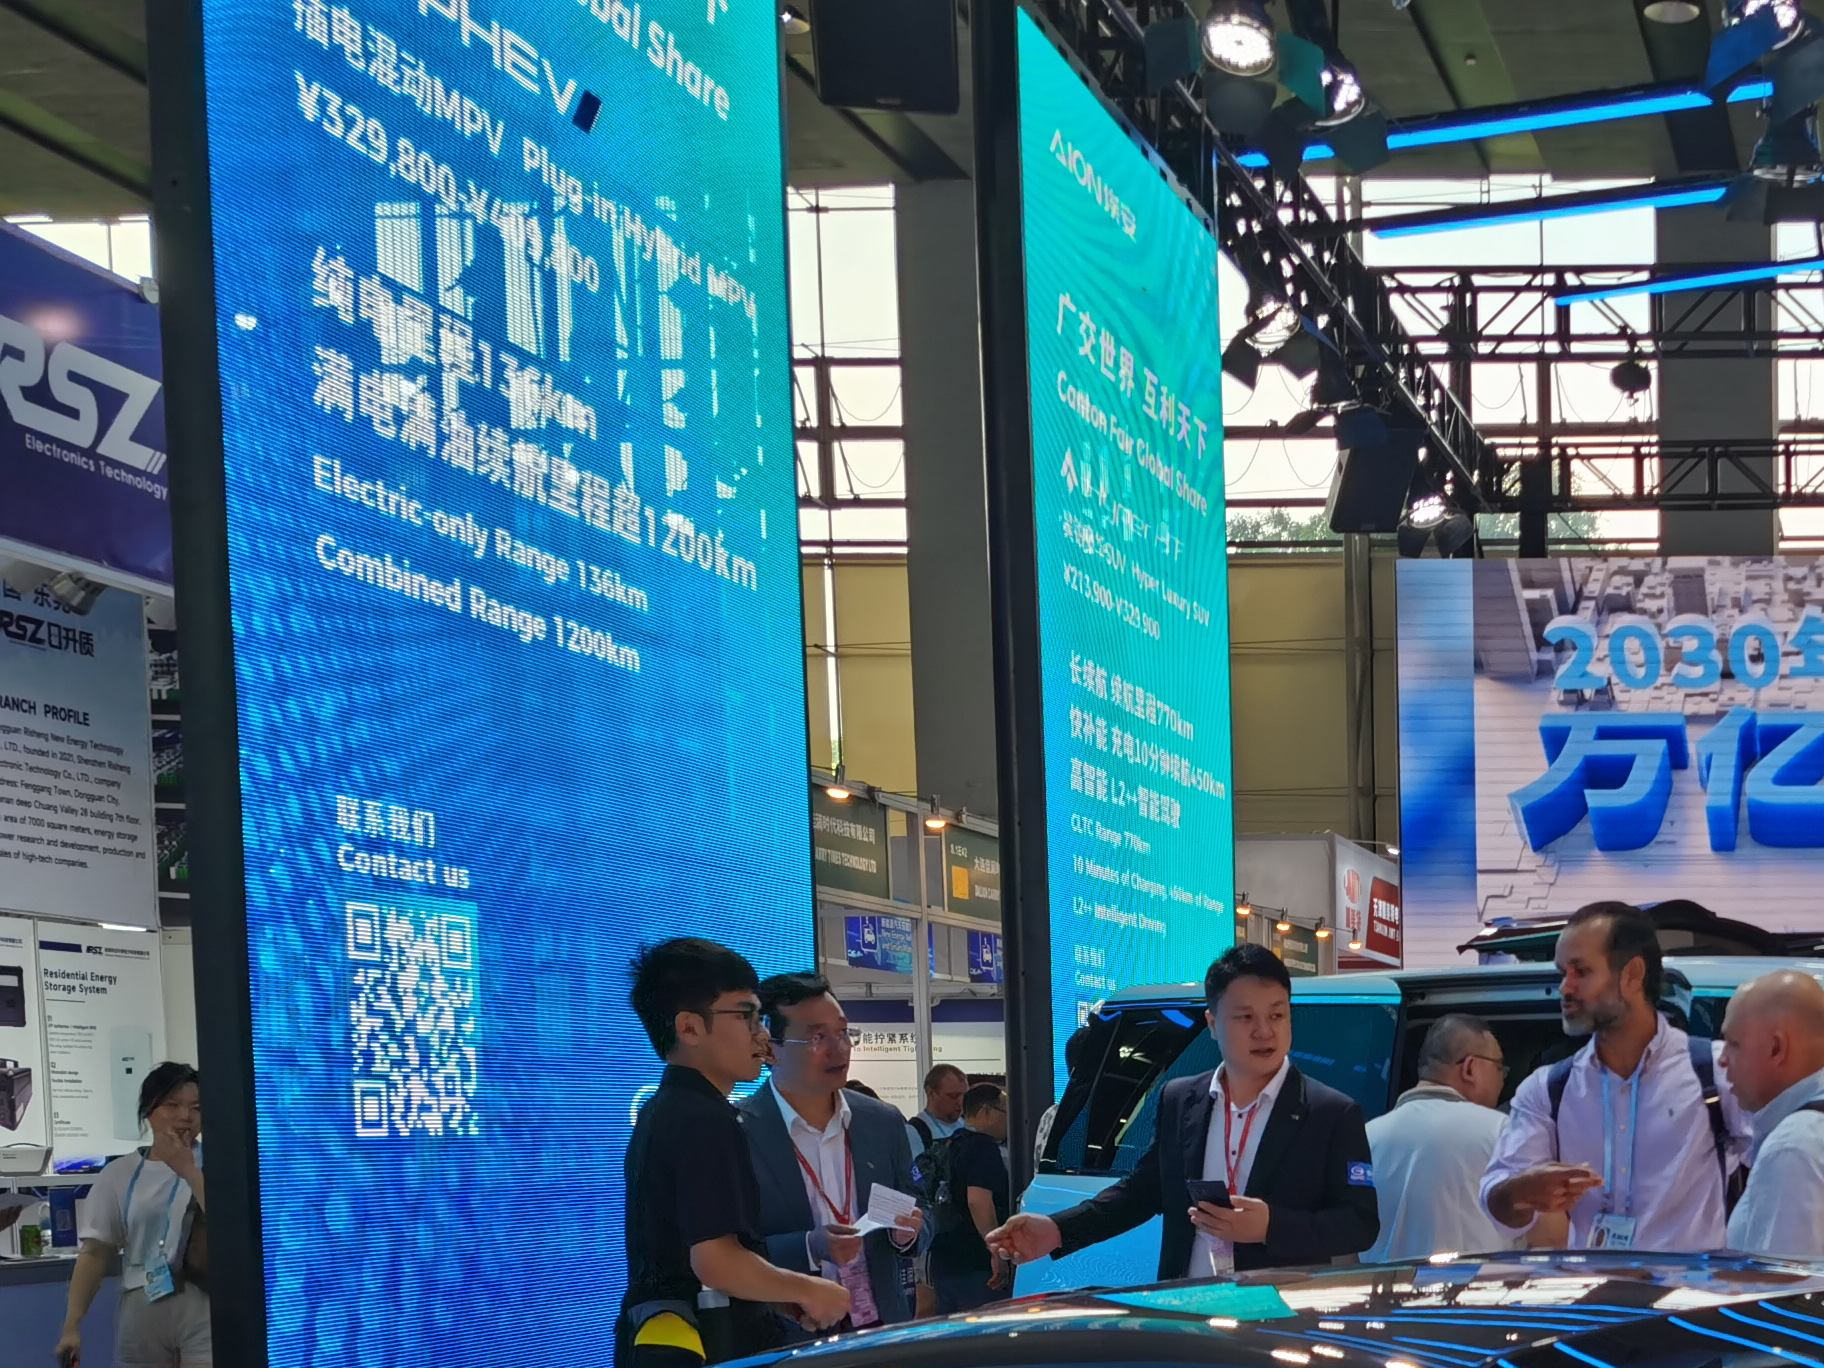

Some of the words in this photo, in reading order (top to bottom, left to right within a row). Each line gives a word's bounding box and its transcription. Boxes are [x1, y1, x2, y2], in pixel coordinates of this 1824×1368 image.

[647, 20, 731, 122] Share
[522, 136, 619, 229] Plug-in
[1056, 292, 1135, 399] 广交世界
[1143, 366, 1208, 460] 互利天下
[25, 433, 95, 472] Electronics
[98, 459, 168, 500] Technology
[312, 454, 489, 560] Electric-only
[494, 526, 570, 584] Range
[576, 560, 649, 611] 136km
[315, 534, 462, 614] Combined
[469, 587, 547, 645] Range
[553, 616, 642, 672] 1200km
[44, 703, 91, 727] PROFILE
[336, 795, 436, 848] 联系我们
[336, 844, 437, 884] Contact
[443, 866, 471, 889] us
[43, 968, 88, 982] Residential
[90, 972, 118, 986] Energy
[44, 981, 76, 995] Storage
[79, 983, 107, 996] System
[1074, 969, 1106, 989] Contact
[863, 1045, 901, 1054] Intelligent
